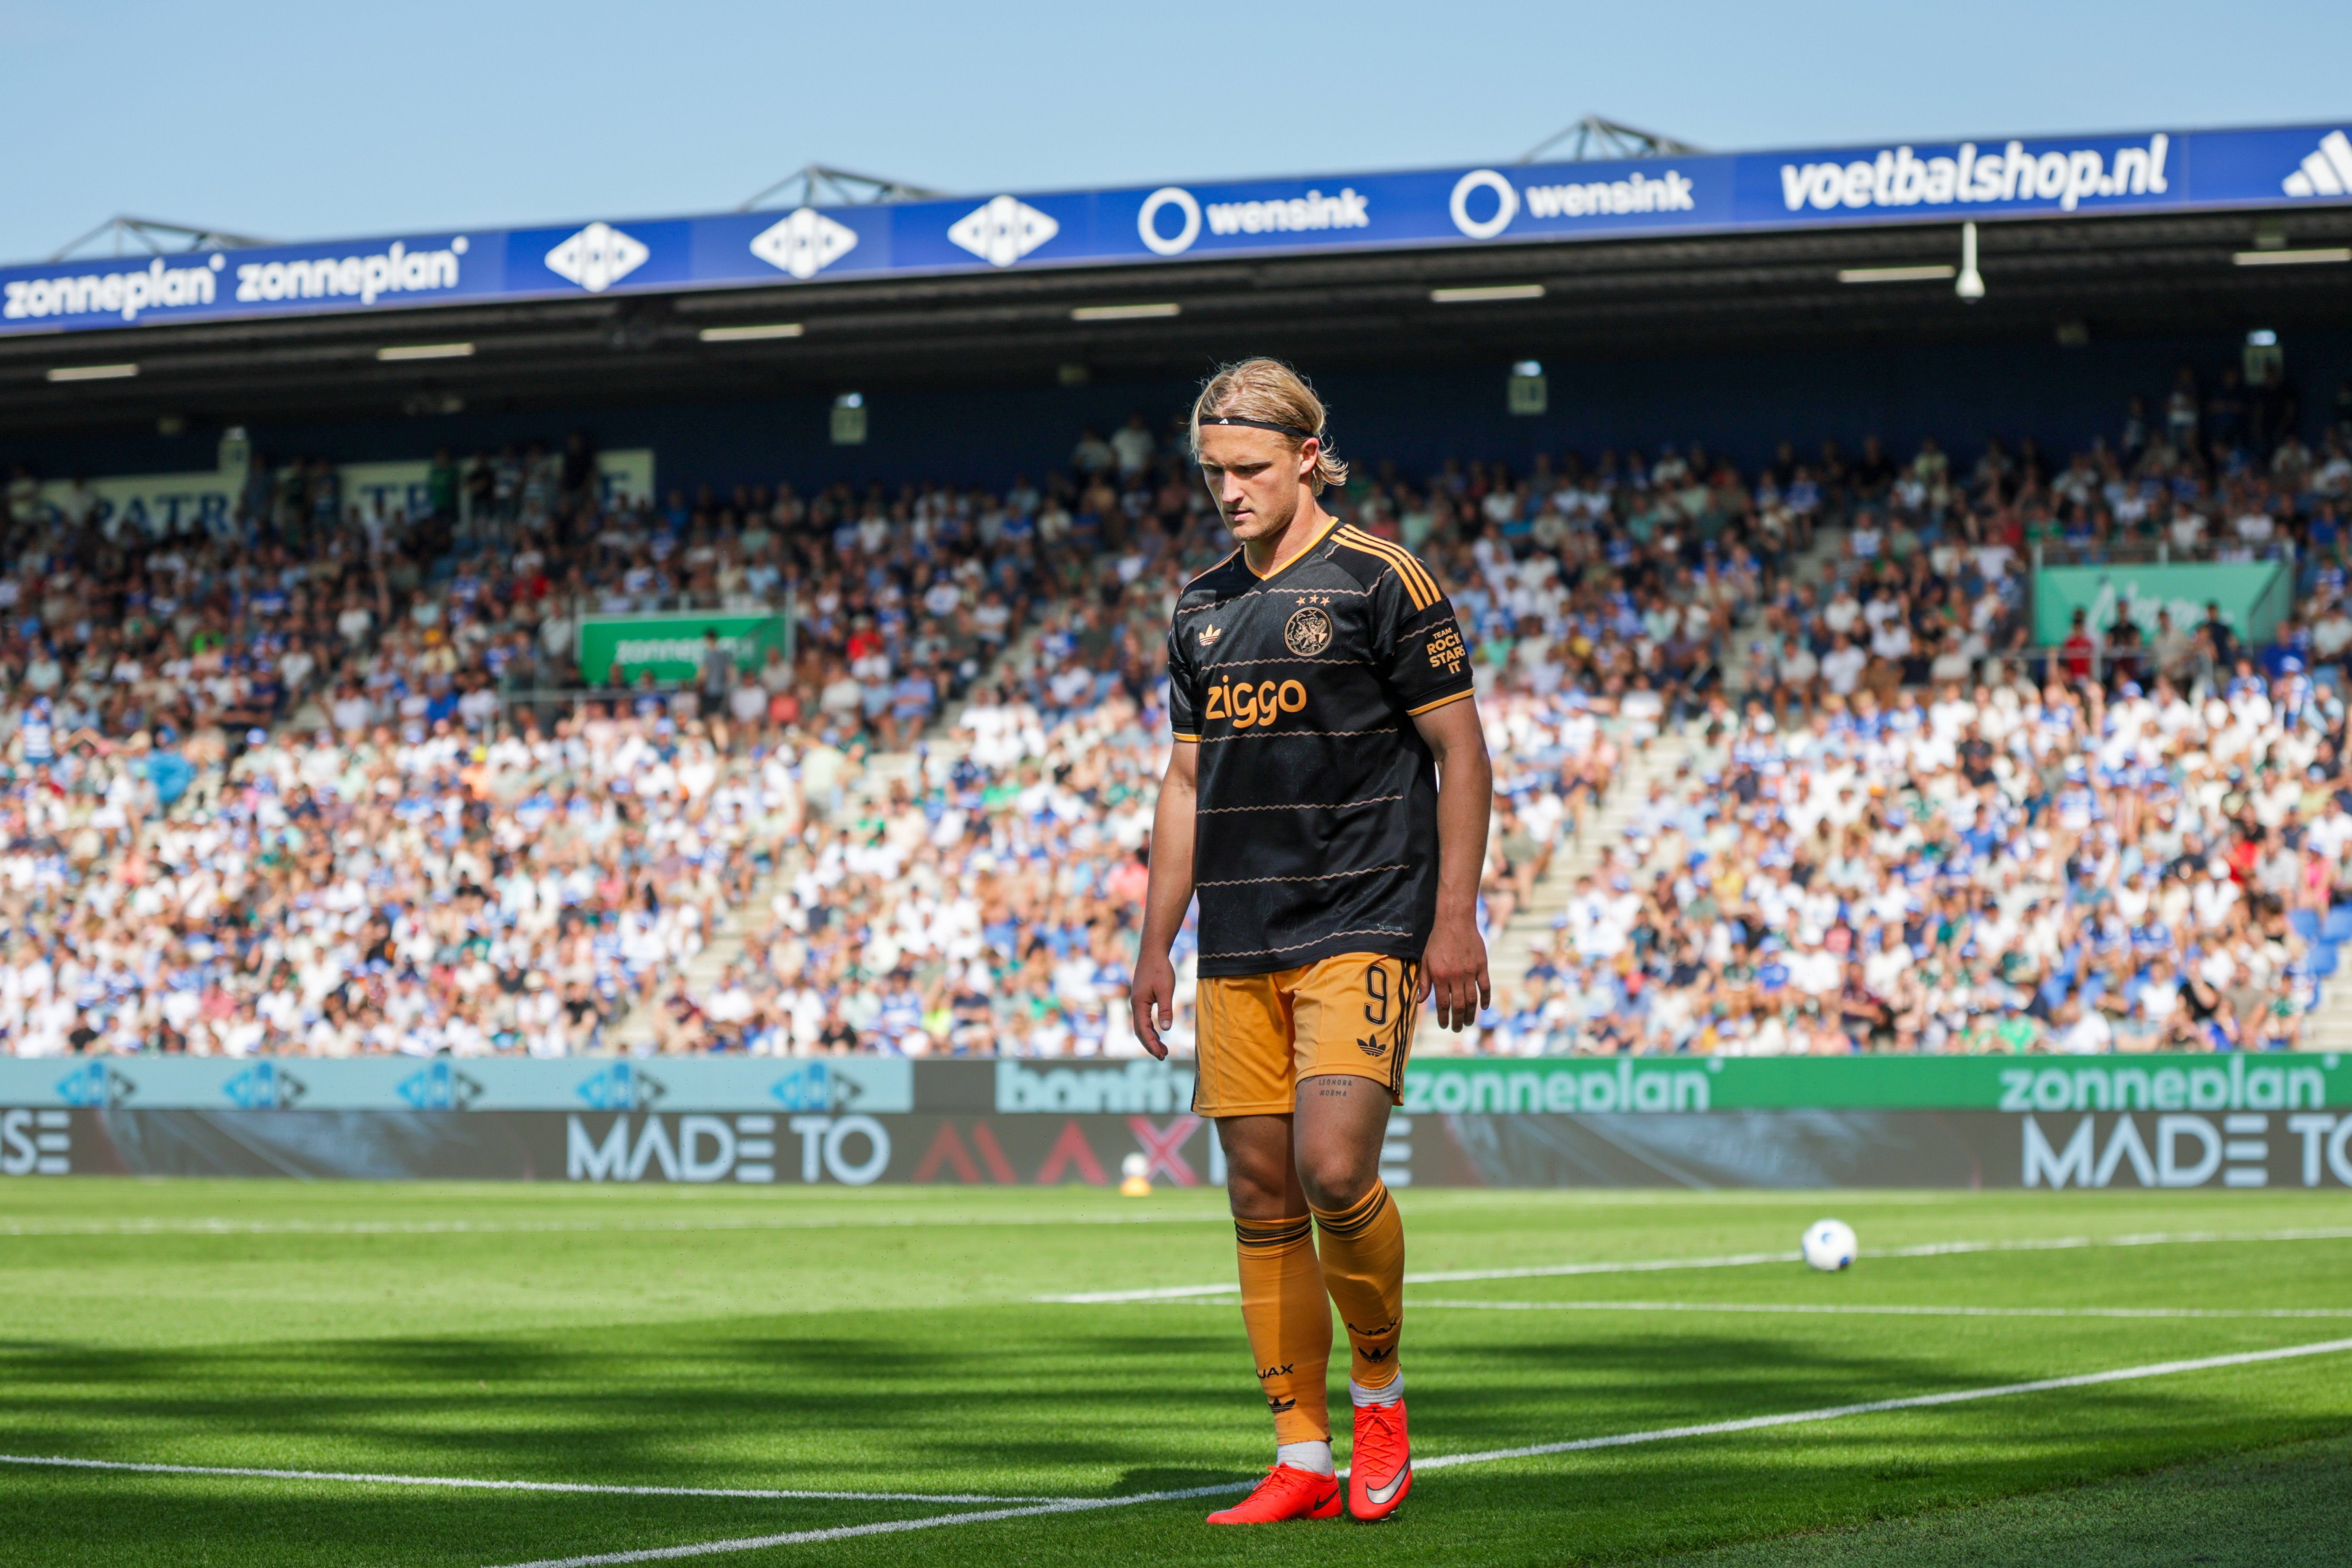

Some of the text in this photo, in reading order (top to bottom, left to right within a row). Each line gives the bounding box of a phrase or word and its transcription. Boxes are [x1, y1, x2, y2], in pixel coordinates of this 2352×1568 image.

[1526, 169, 1695, 218] wensink
[1780, 133, 2169, 212] voetbalshop.nl
[1206, 188, 1371, 237] wensink
[1287, 610, 1317, 641] AJAX
[1426, 633, 1461, 655] ROCK
[1433, 627, 1452, 639] TEAM
[1448, 660, 1460, 674] IT
[1206, 675, 1307, 729] ziggo
[1364, 964, 1388, 1026] 9
[567, 1114, 892, 1185] MADE TO
[2022, 1114, 2269, 1190] MADE
